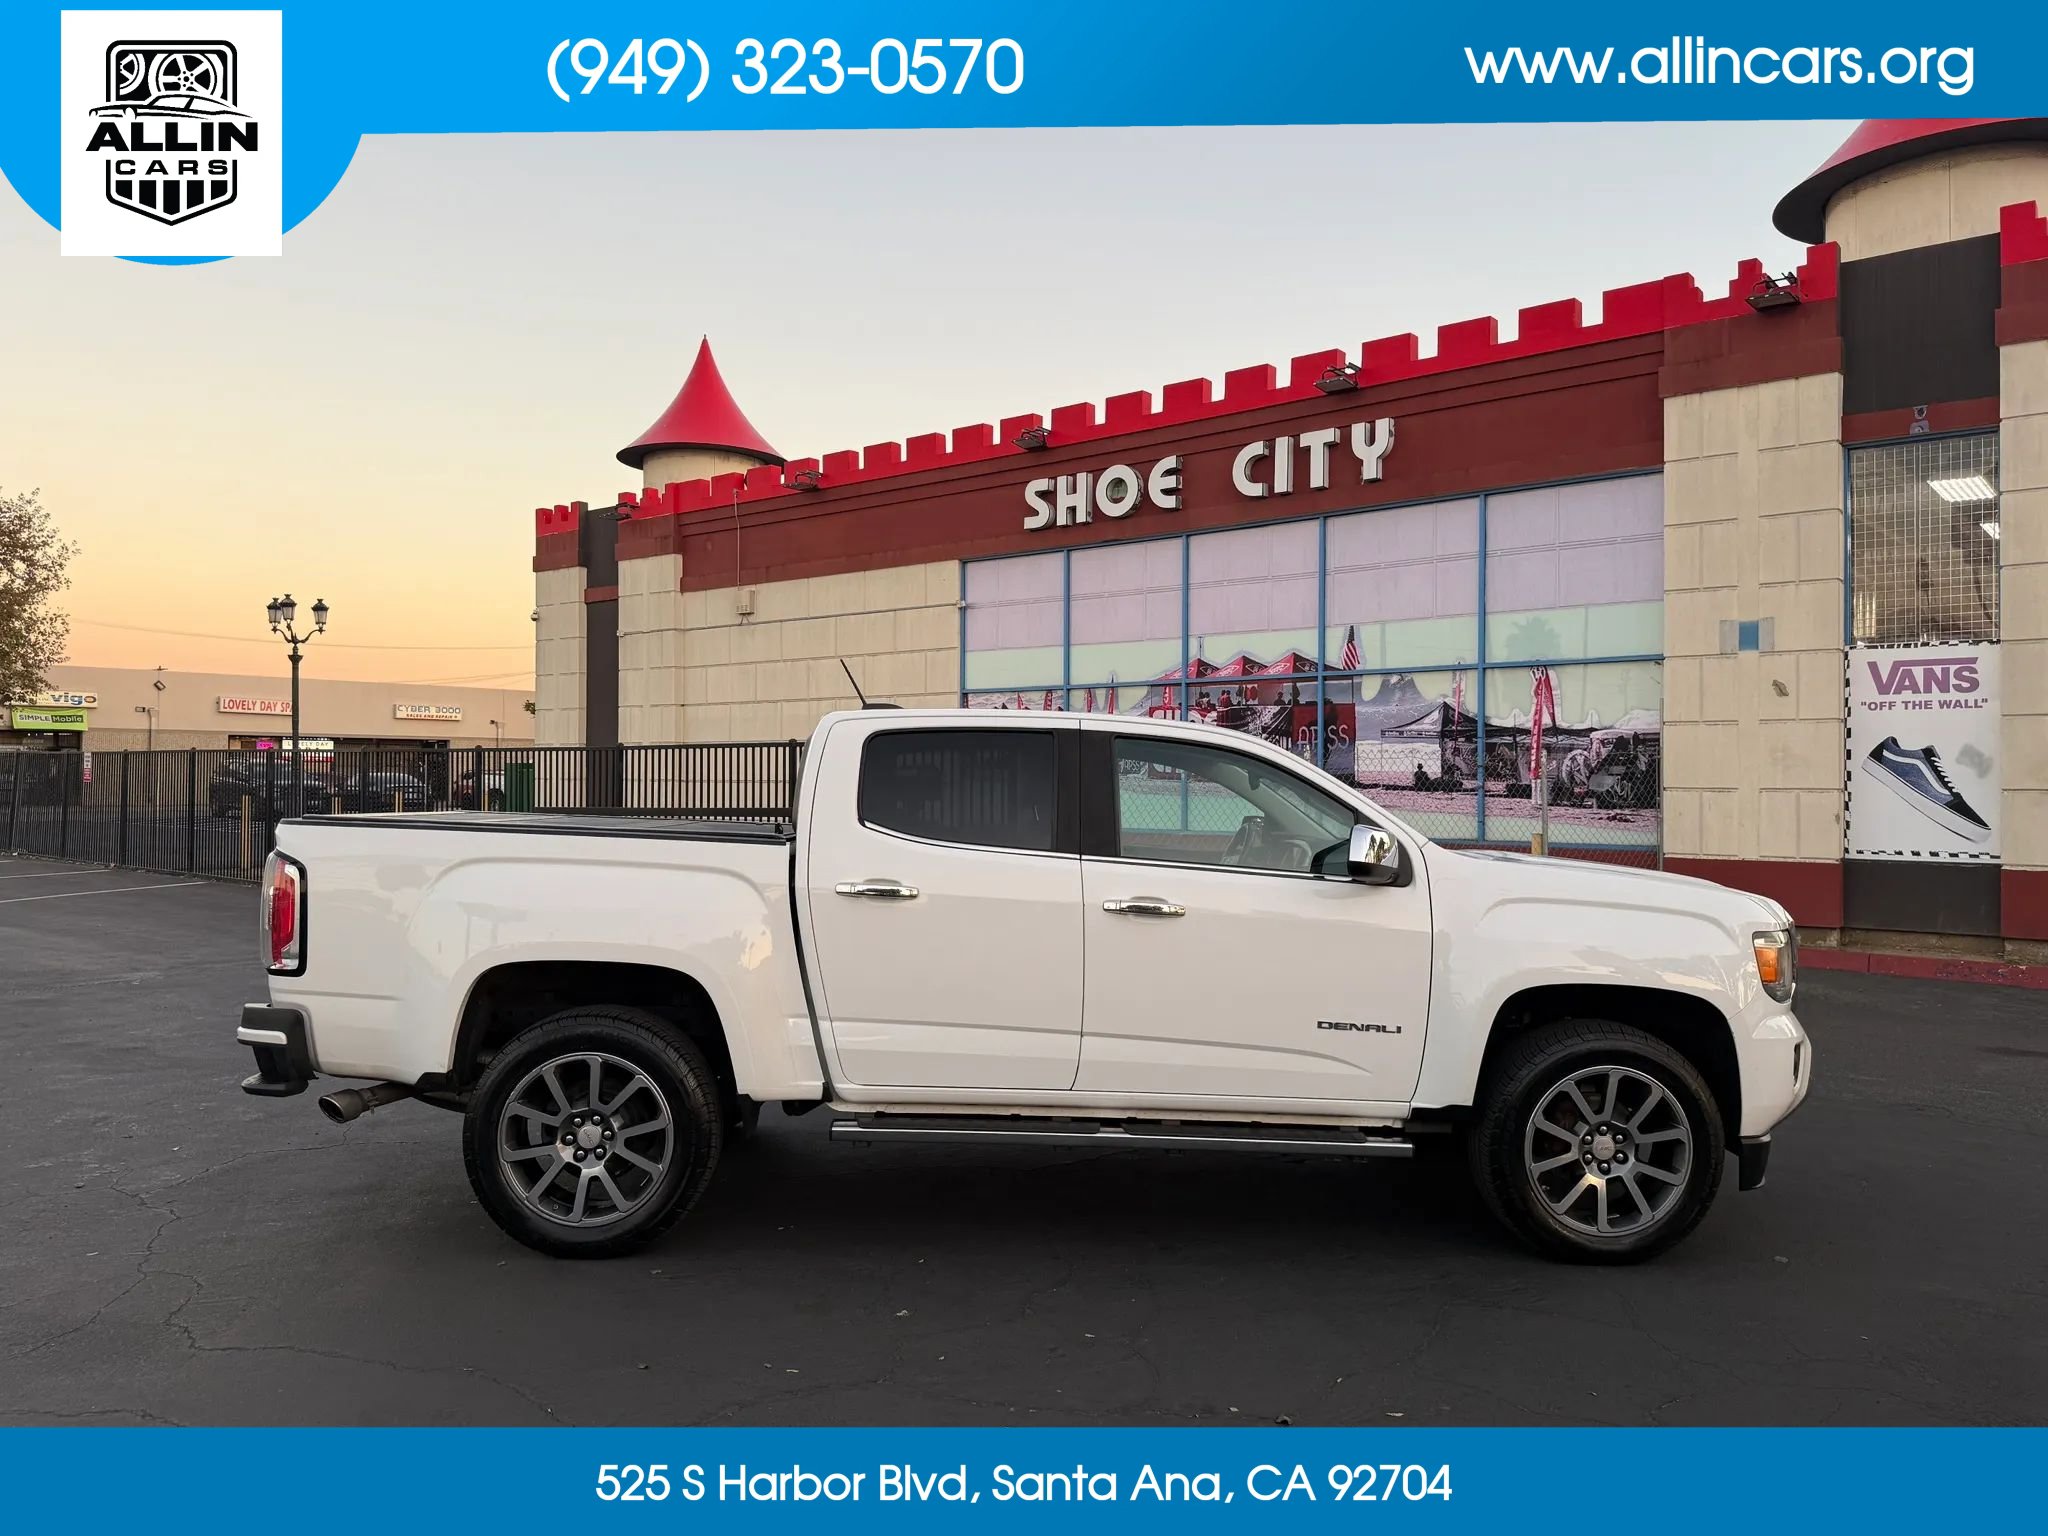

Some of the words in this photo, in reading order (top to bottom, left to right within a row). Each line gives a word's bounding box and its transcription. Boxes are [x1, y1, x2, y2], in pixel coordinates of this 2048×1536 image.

[1024, 455, 1183, 531] SHOE
[1232, 418, 1394, 497] CITY
[1867, 657, 1980, 695] VANS
[50, 692, 97, 705] vigo
[1861, 701, 1896, 711] "OFF
[1902, 700, 1933, 710] THE
[1938, 698, 1988, 709] WALL"
[222, 699, 257, 710] LOVELY
[260, 701, 278, 712] DAY
[397, 705, 431, 713] CYBER
[19, 714, 51, 722] SIMPLE
[1317, 1021, 1402, 1034] DENALI
